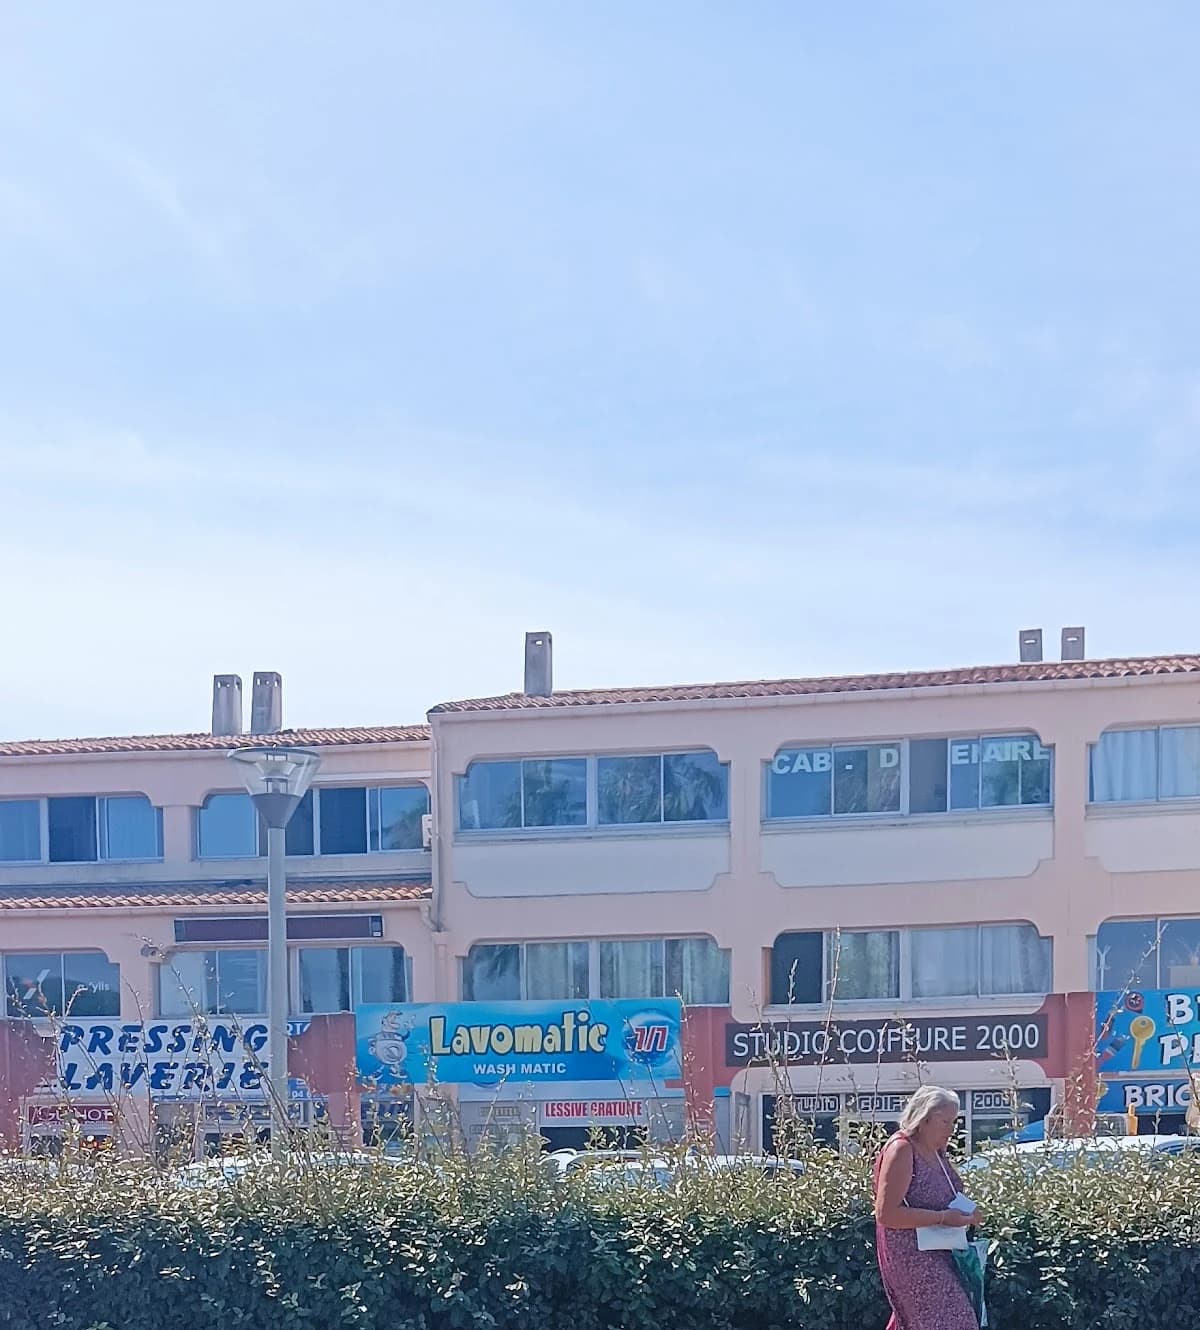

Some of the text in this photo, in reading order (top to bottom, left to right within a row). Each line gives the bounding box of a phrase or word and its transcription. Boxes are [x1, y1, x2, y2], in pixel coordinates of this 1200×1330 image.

[59, 1024, 269, 1055] PRESSING
[429, 1011, 608, 1056] Lavomatic
[633, 1025, 669, 1052] 7/7
[733, 1022, 1040, 1058] STUDIO COIFFURE 2000
[64, 1061, 269, 1091] LAVERIE
[473, 1062, 567, 1075] WASH MATIC
[545, 1102, 587, 1118] LESSIVE
